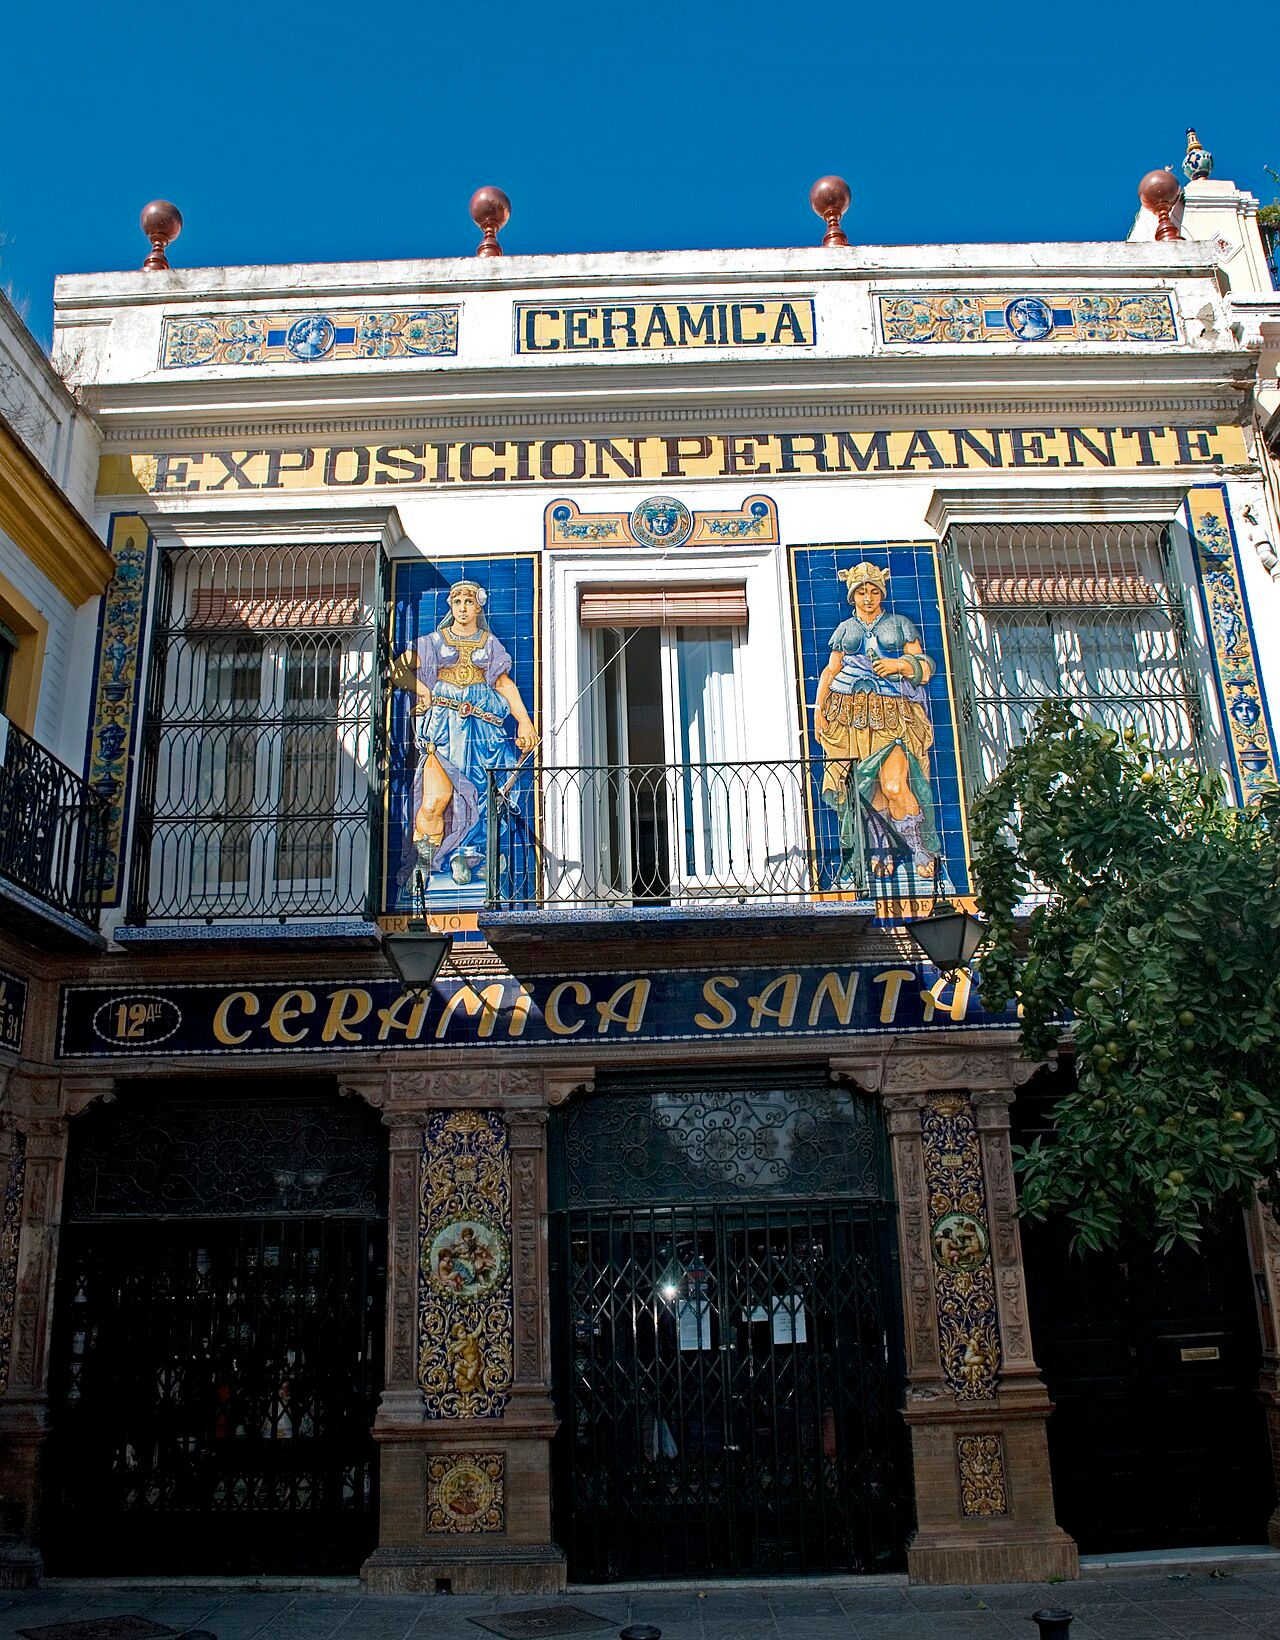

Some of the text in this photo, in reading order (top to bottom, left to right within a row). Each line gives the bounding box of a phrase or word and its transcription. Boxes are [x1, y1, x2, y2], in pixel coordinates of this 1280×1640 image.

[525, 303, 807, 350] CERAMICA
[149, 426, 1224, 493] EXPOSICION PERMANENTE
[380, 916, 461, 932] TRAJO
[695, 966, 973, 1030] SANTA
